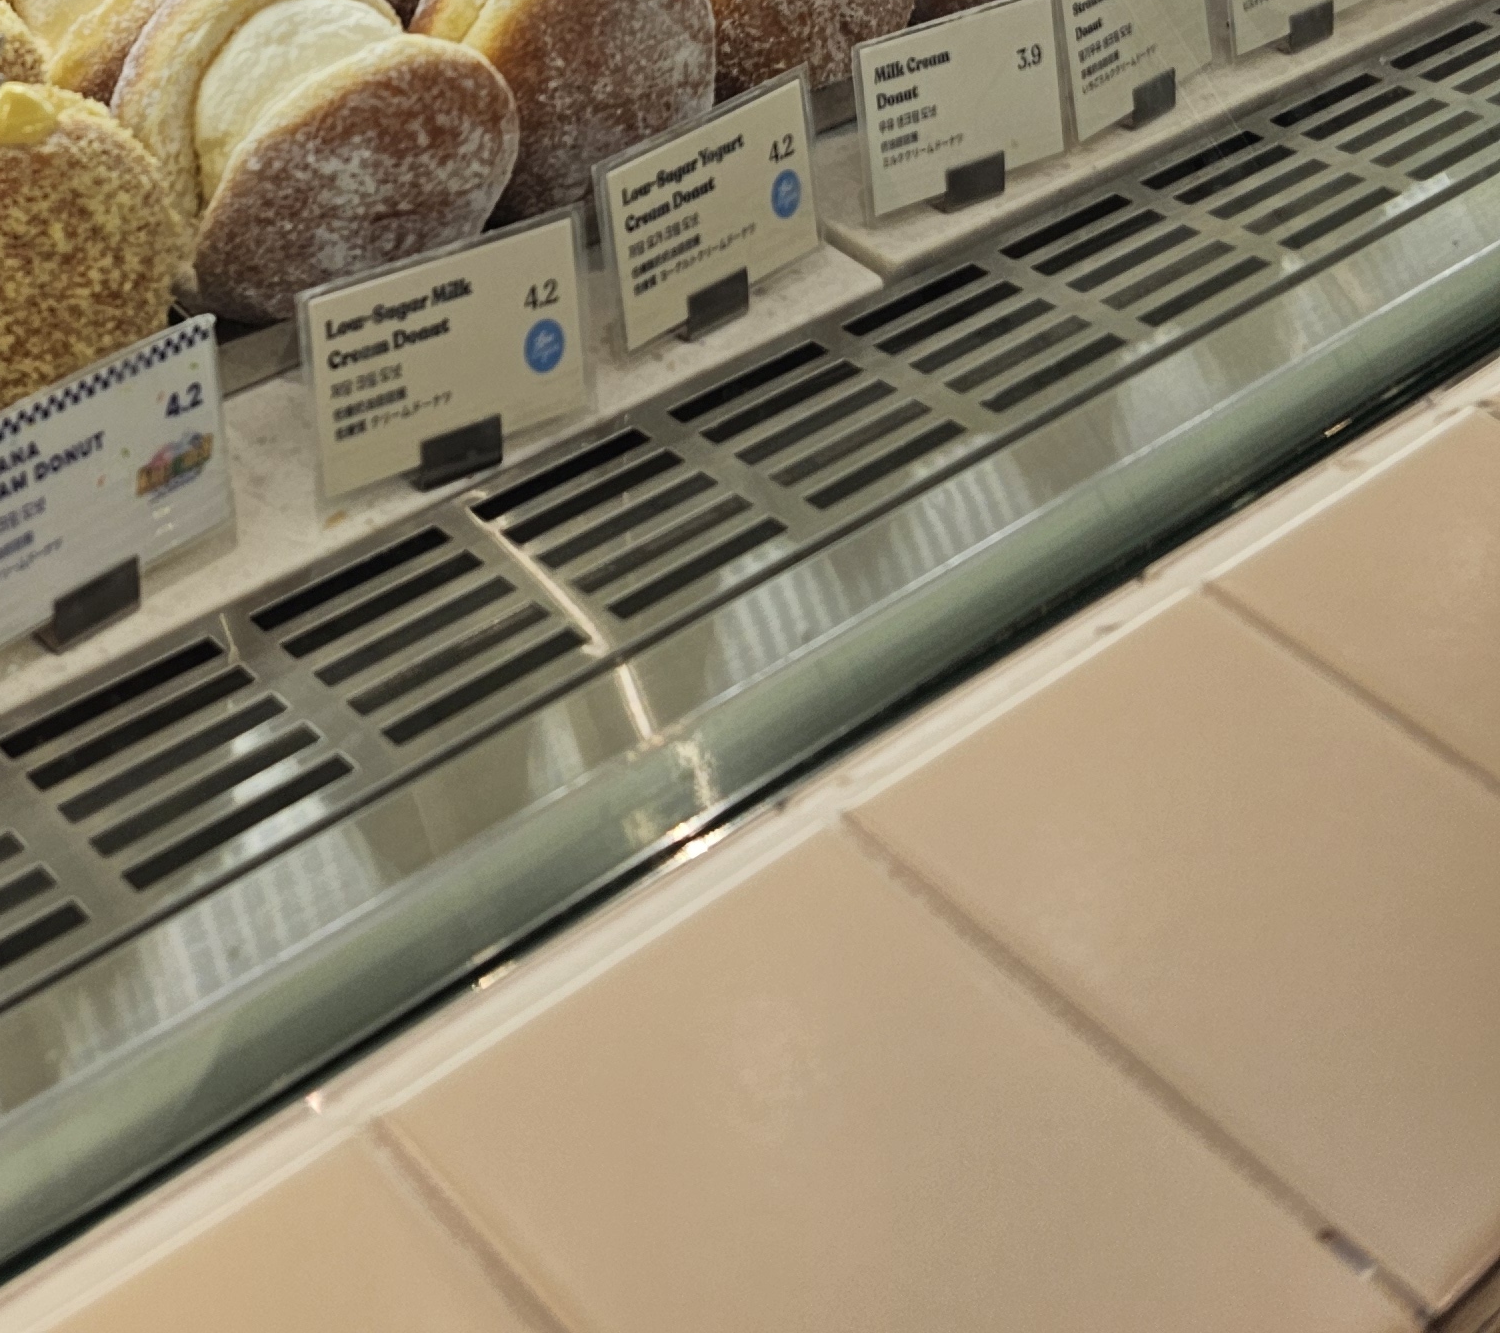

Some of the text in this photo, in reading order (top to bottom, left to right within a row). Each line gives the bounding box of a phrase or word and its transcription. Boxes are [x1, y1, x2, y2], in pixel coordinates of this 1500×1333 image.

[1075, 16, 1103, 41] Donut
[873, 50, 951, 85] Milk Cream
[1016, 43, 1043, 71] 3.9
[876, 85, 919, 111] Donut
[768, 133, 796, 164] 4.2
[621, 133, 745, 207] Low-Sugar Yogurt
[625, 176, 716, 233] Cream Donut
[324, 277, 474, 341] Low-Sugar Milk
[523, 278, 560, 311] 4.2
[327, 316, 451, 372] Cream Donut
[165, 381, 204, 418] 4.2
[33, 430, 106, 483] DONUT
